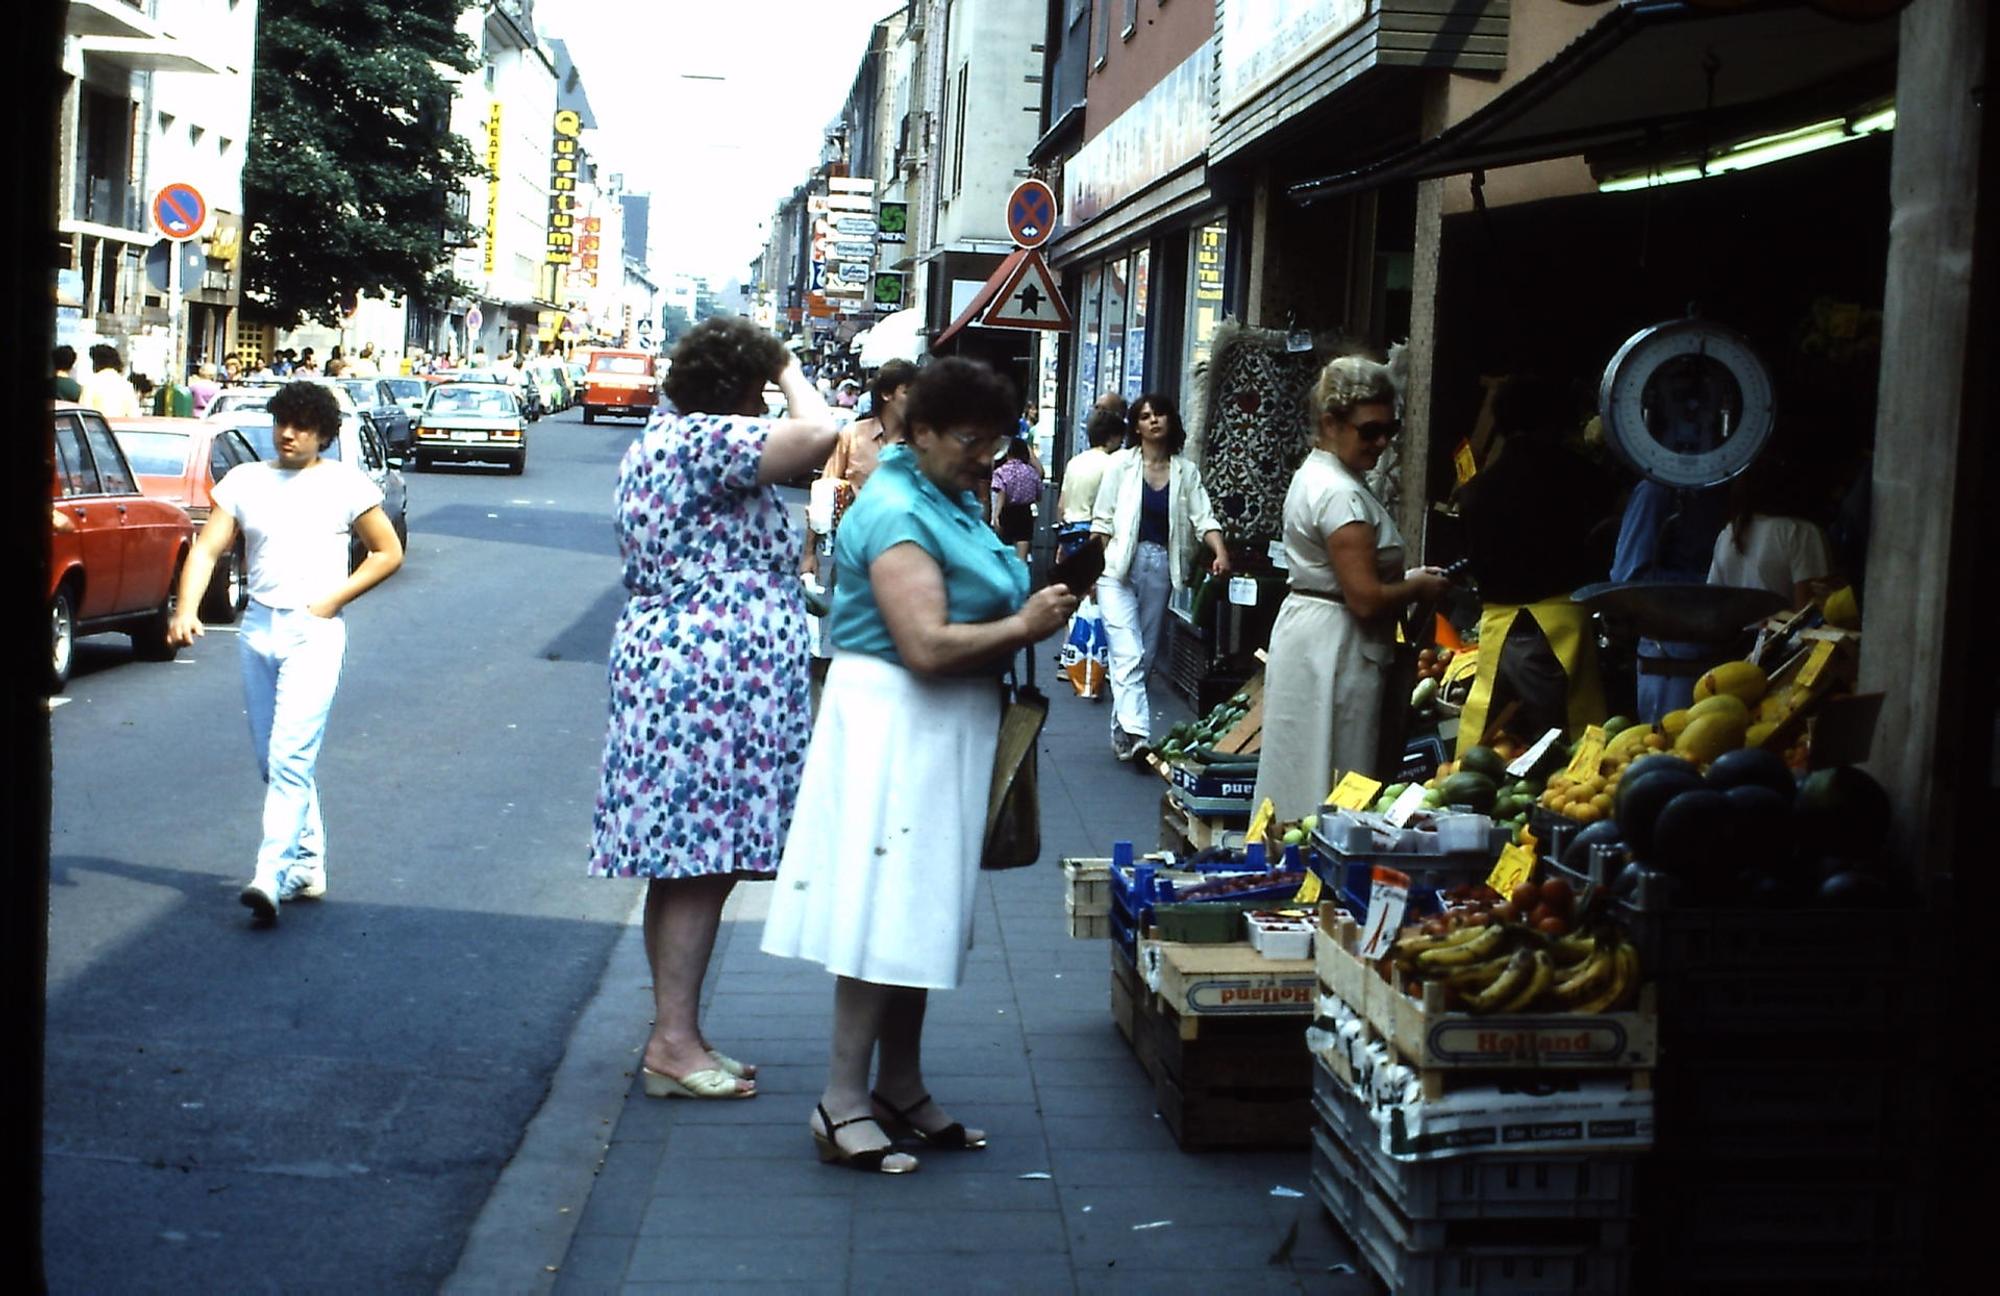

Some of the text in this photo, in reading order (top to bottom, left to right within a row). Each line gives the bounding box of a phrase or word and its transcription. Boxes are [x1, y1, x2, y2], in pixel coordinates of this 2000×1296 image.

[548, 111, 581, 246] Quantum
[1220, 987, 1311, 1004] Holland
[1476, 1031, 1592, 1051] Holland
